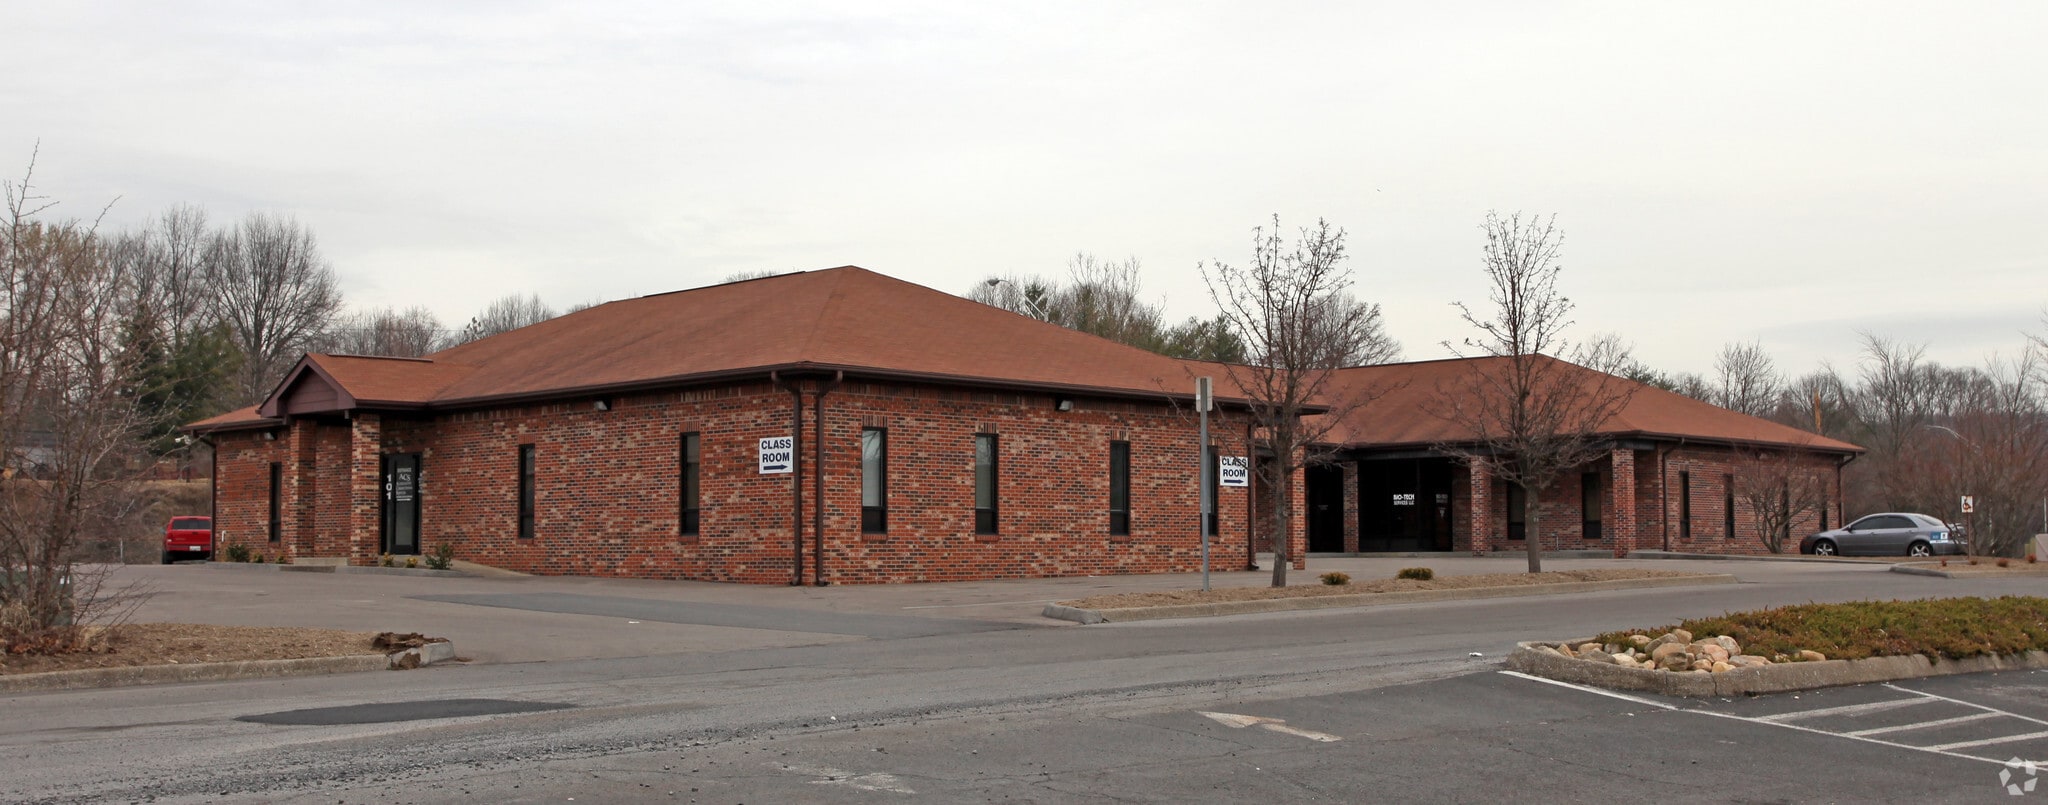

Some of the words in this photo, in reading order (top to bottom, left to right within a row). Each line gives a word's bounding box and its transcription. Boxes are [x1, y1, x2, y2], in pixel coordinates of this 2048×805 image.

[761, 439, 791, 449] CLASS
[762, 452, 790, 463] ROOM
[1222, 457, 1247, 466] CLASS
[1222, 469, 1246, 477] ROOM
